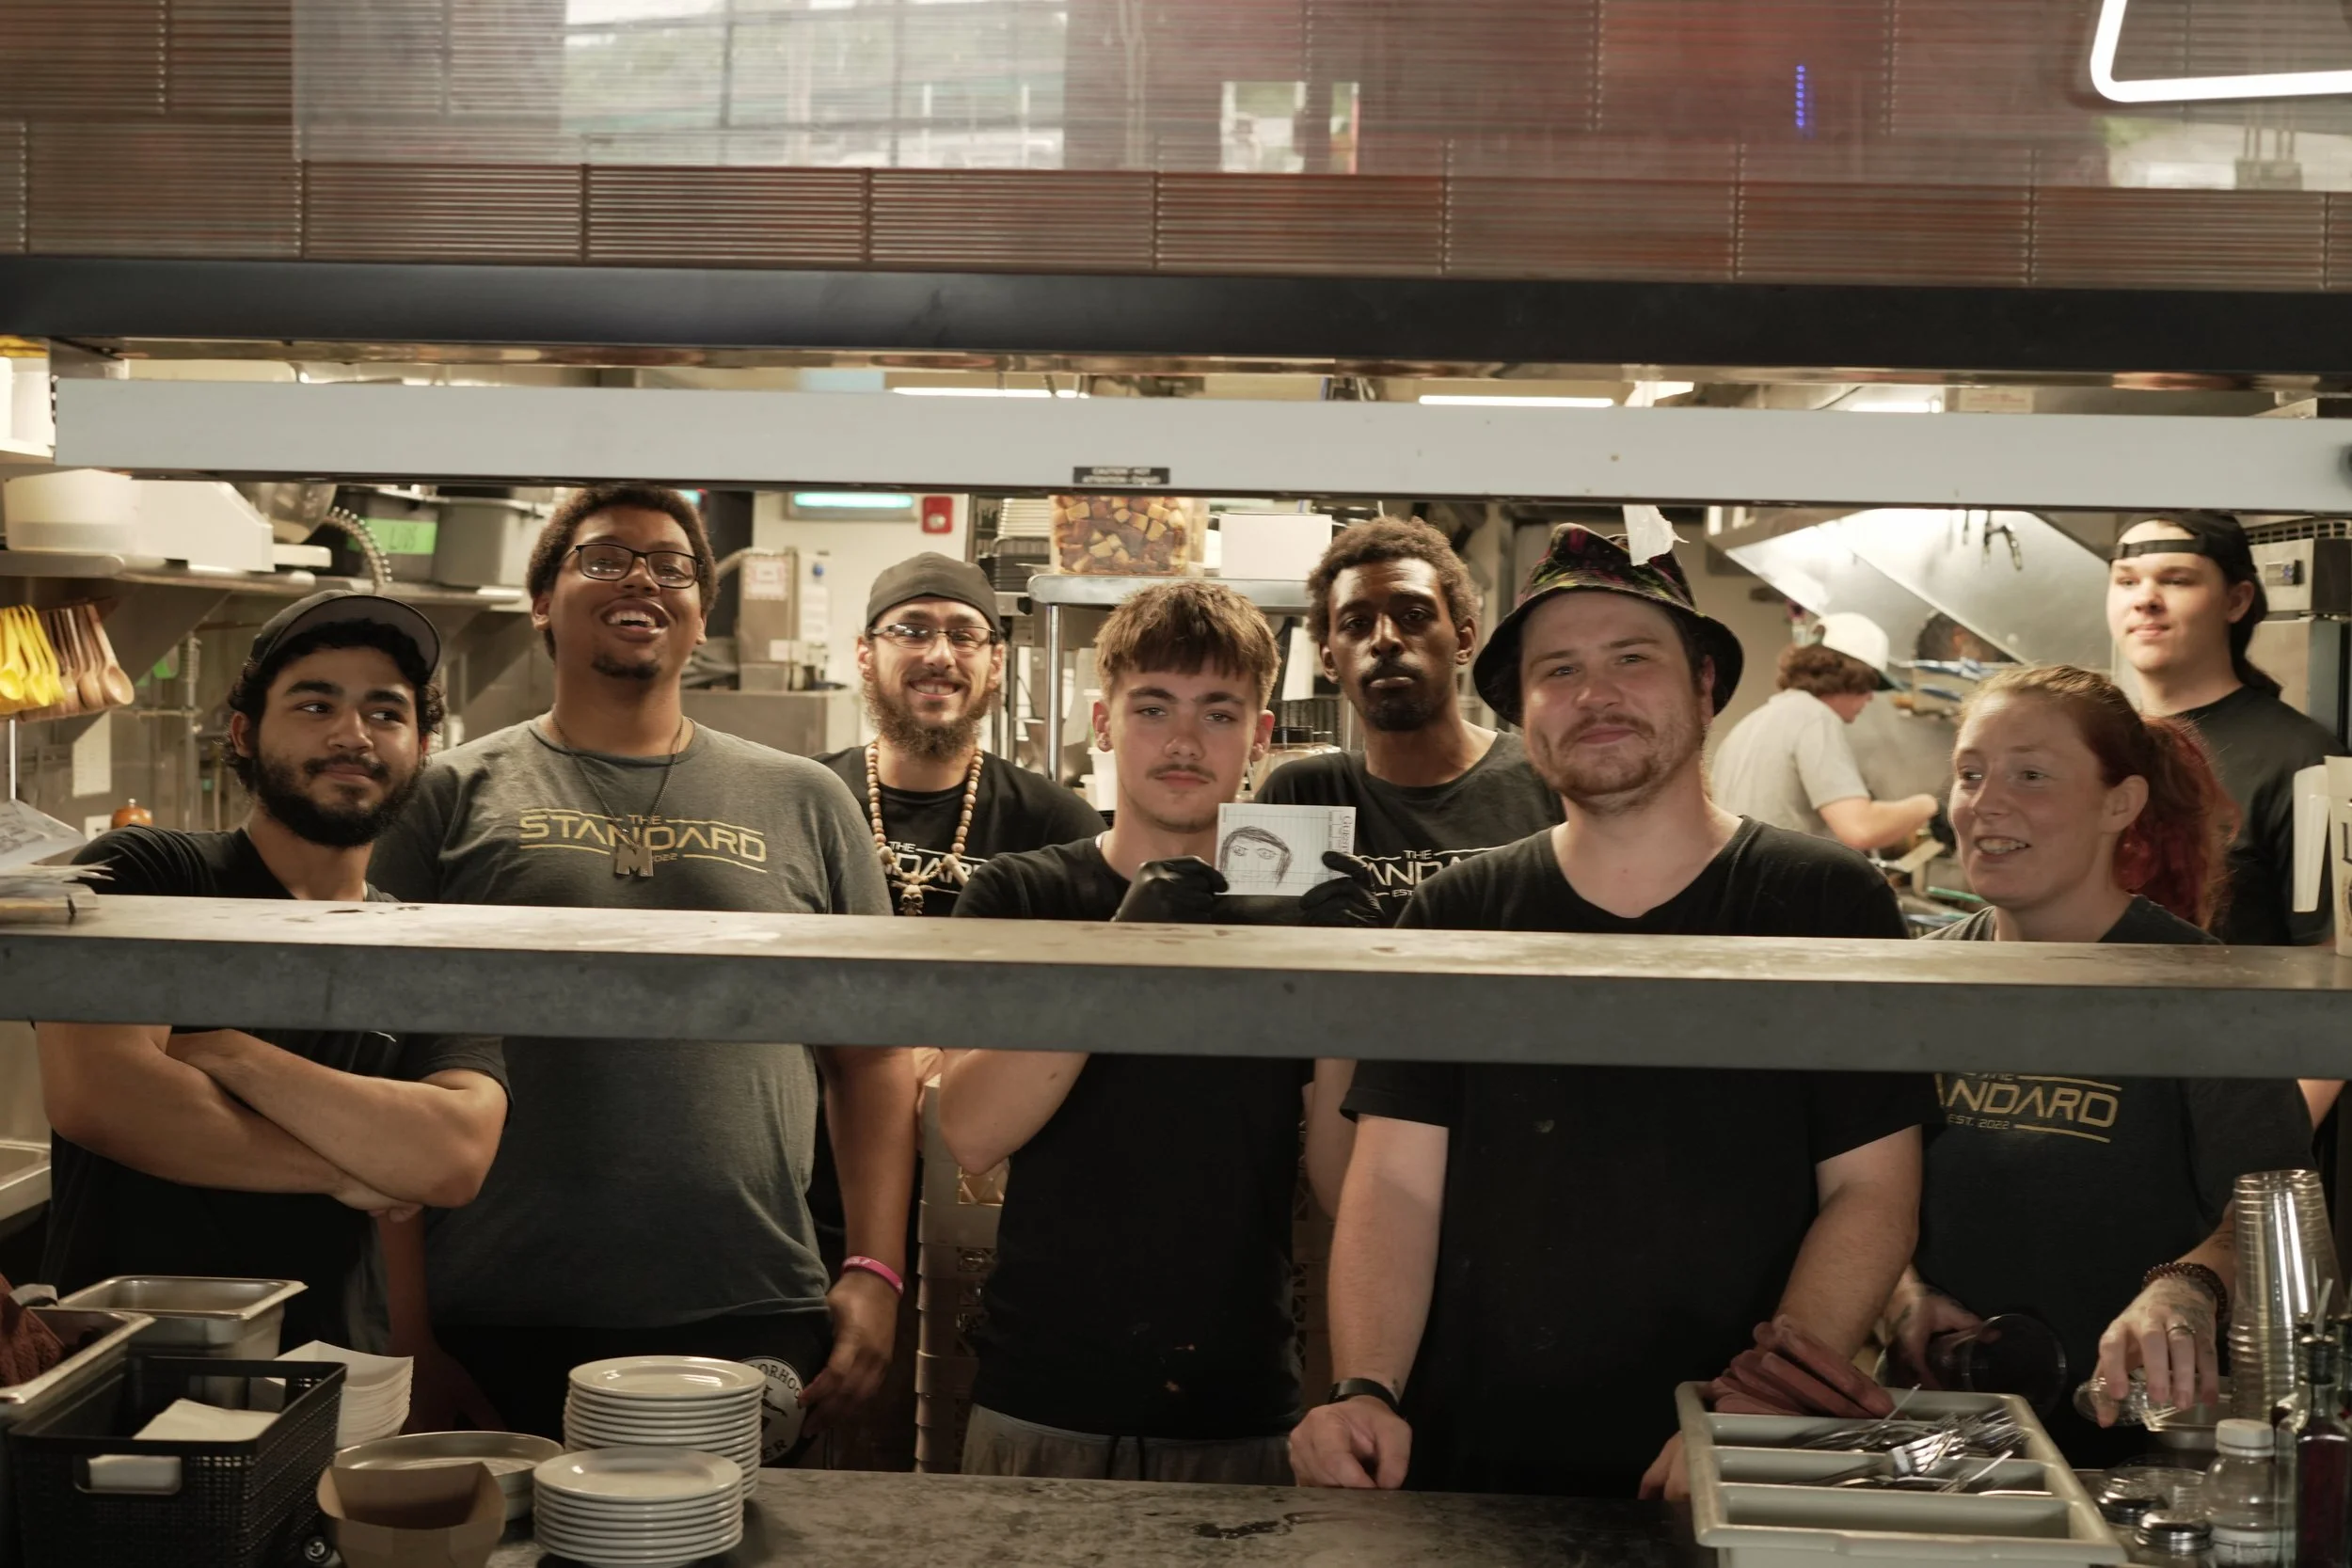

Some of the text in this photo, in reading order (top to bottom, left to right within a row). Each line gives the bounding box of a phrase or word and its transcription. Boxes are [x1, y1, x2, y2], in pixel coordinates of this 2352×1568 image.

[628, 814, 661, 825] THE
[519, 815, 767, 863] STANDARD
[888, 841, 916, 853] THE
[1404, 849, 1433, 860] THE
[1979, 1118, 2010, 1130] 2022
